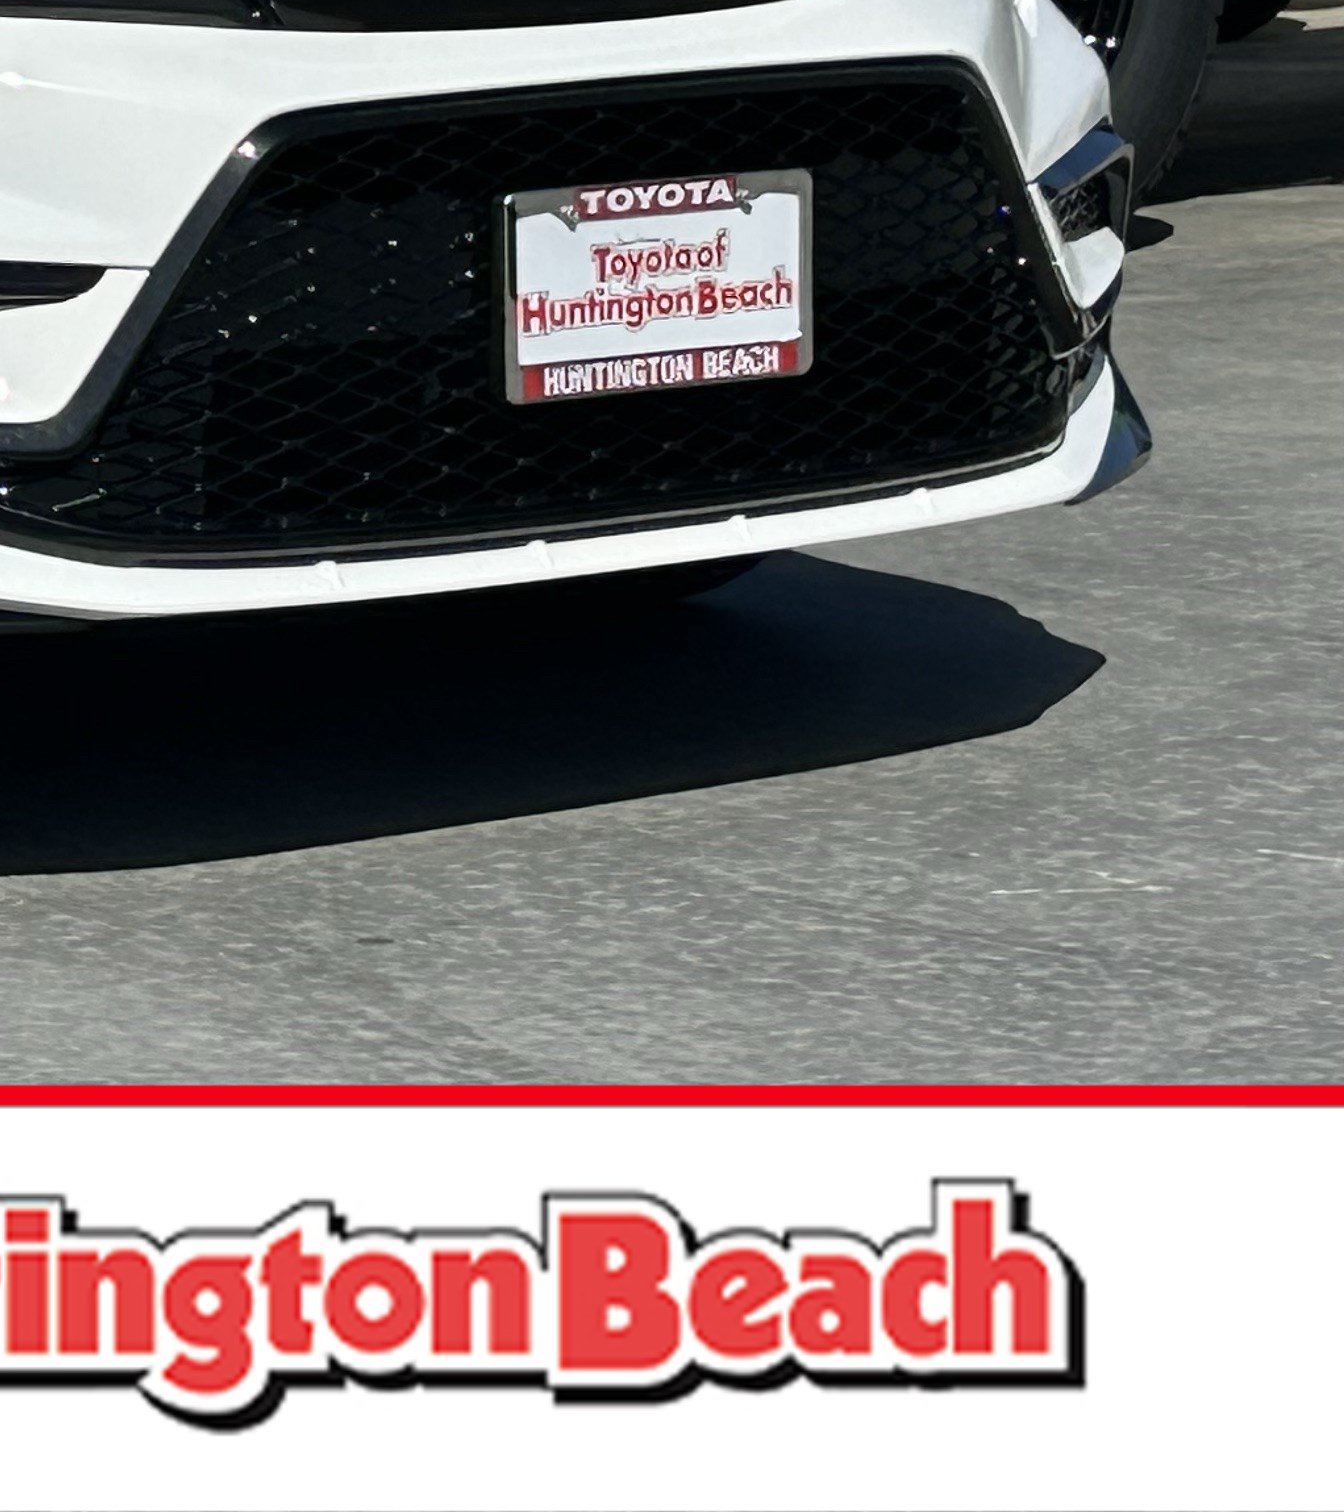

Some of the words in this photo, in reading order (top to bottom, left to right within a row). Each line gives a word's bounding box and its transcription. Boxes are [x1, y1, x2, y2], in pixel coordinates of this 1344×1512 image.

[580, 178, 734, 215] TOYOTA
[592, 241, 694, 284] Toyota
[696, 232, 728, 270] of
[521, 287, 694, 334] Huntington
[696, 268, 793, 316] Beach
[543, 353, 694, 397] HUNTINGTON
[702, 345, 780, 379] BEACH
